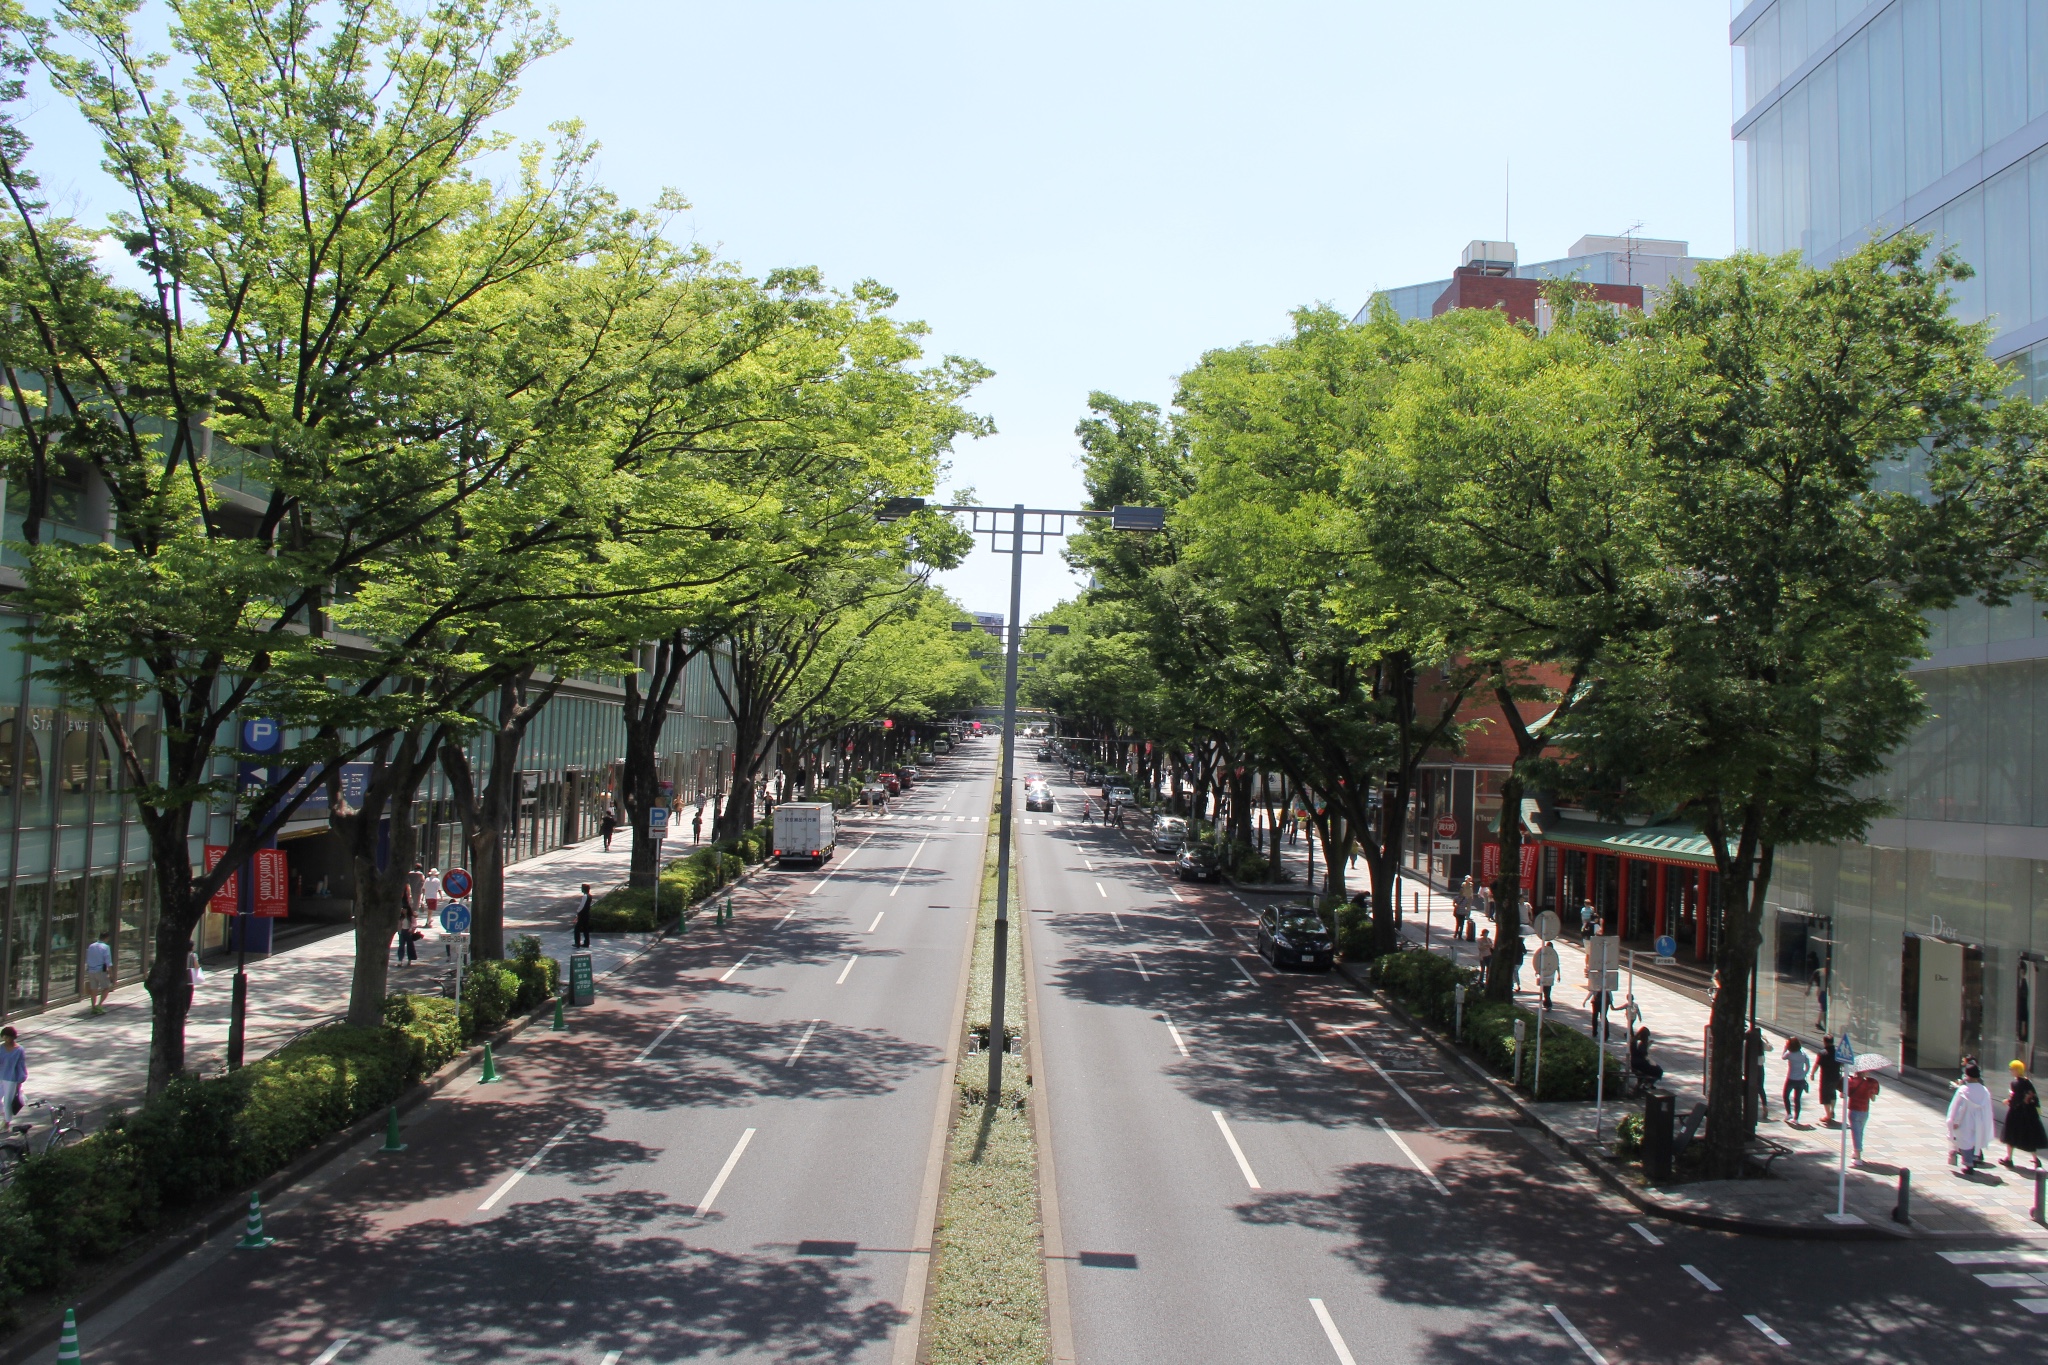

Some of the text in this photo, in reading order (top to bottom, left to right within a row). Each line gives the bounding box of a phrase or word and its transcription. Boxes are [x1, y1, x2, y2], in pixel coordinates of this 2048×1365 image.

[252, 723, 272, 742] P
[651, 809, 667, 826] P
[1438, 822, 1455, 832] 消火栓
[447, 911, 459, 929] P
[455, 921, 464, 930] 60
[1932, 914, 1958, 939] Dior
